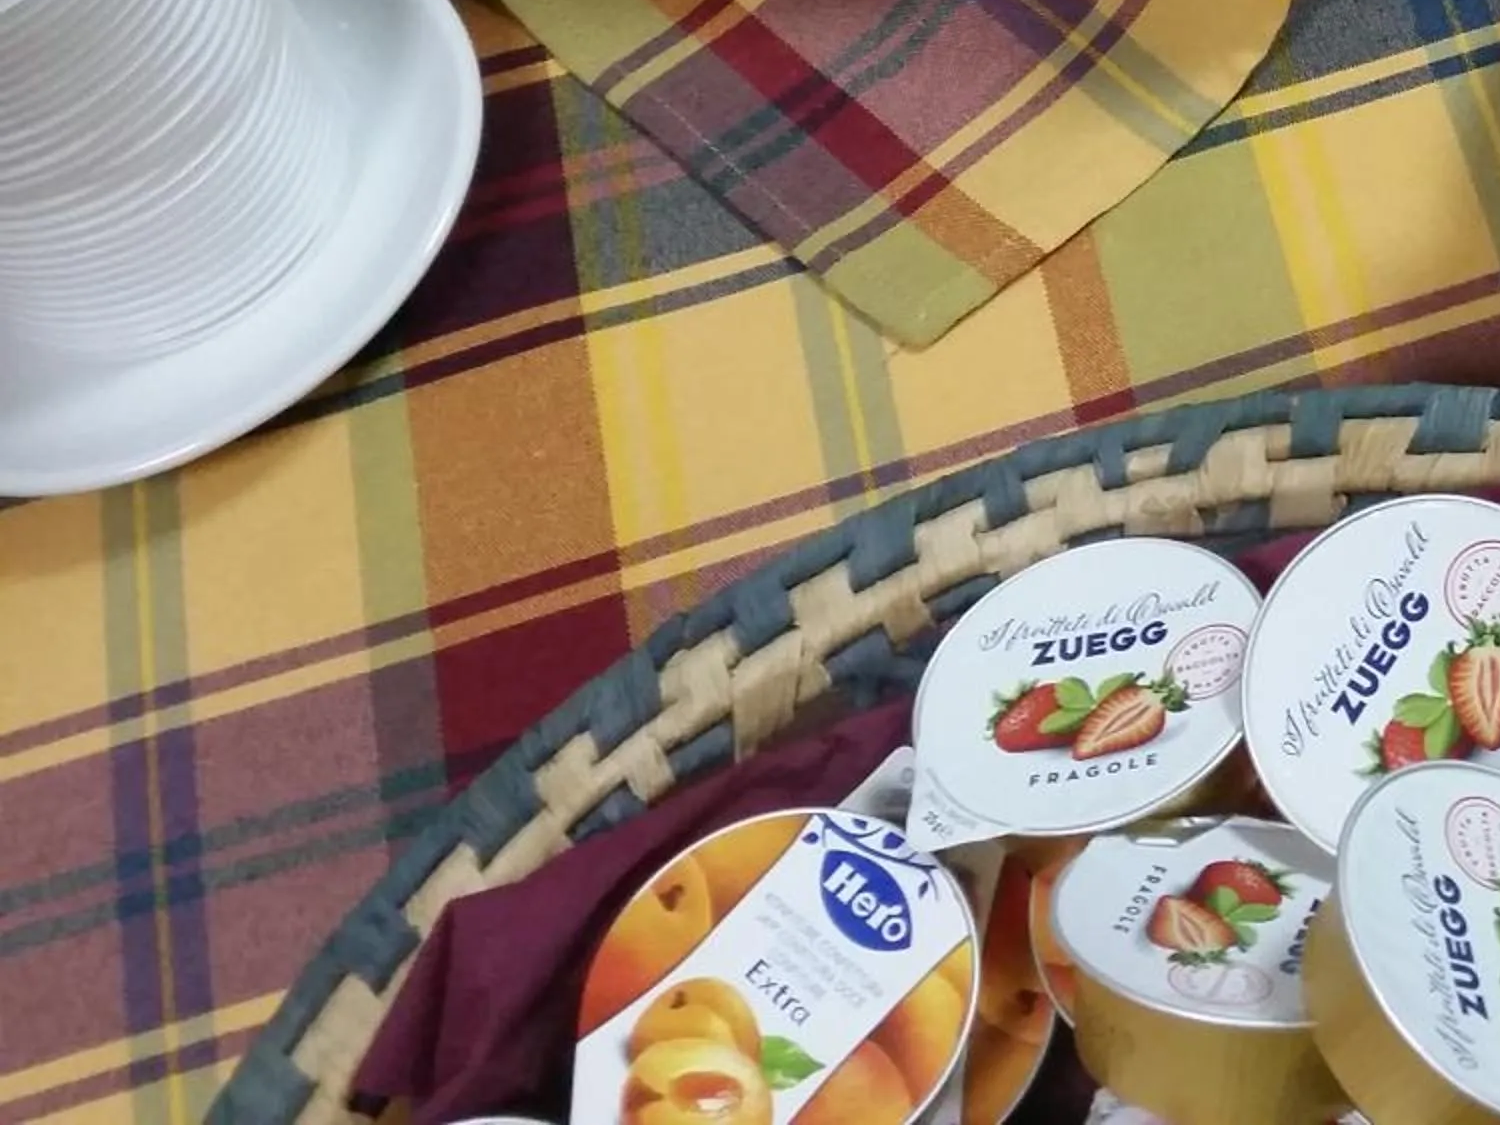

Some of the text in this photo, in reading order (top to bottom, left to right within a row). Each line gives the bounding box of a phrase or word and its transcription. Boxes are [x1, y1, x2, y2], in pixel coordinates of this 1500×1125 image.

[1031, 620, 1170, 667] ZUEGG
[1331, 591, 1430, 726] ZUEGG
[1029, 753, 1159, 788] FRAGOLE
[822, 861, 908, 943] Hero
[1112, 864, 1168, 934] FRAGOLE
[1433, 875, 1490, 1021] ZUEGG
[745, 958, 812, 1027] Extra
